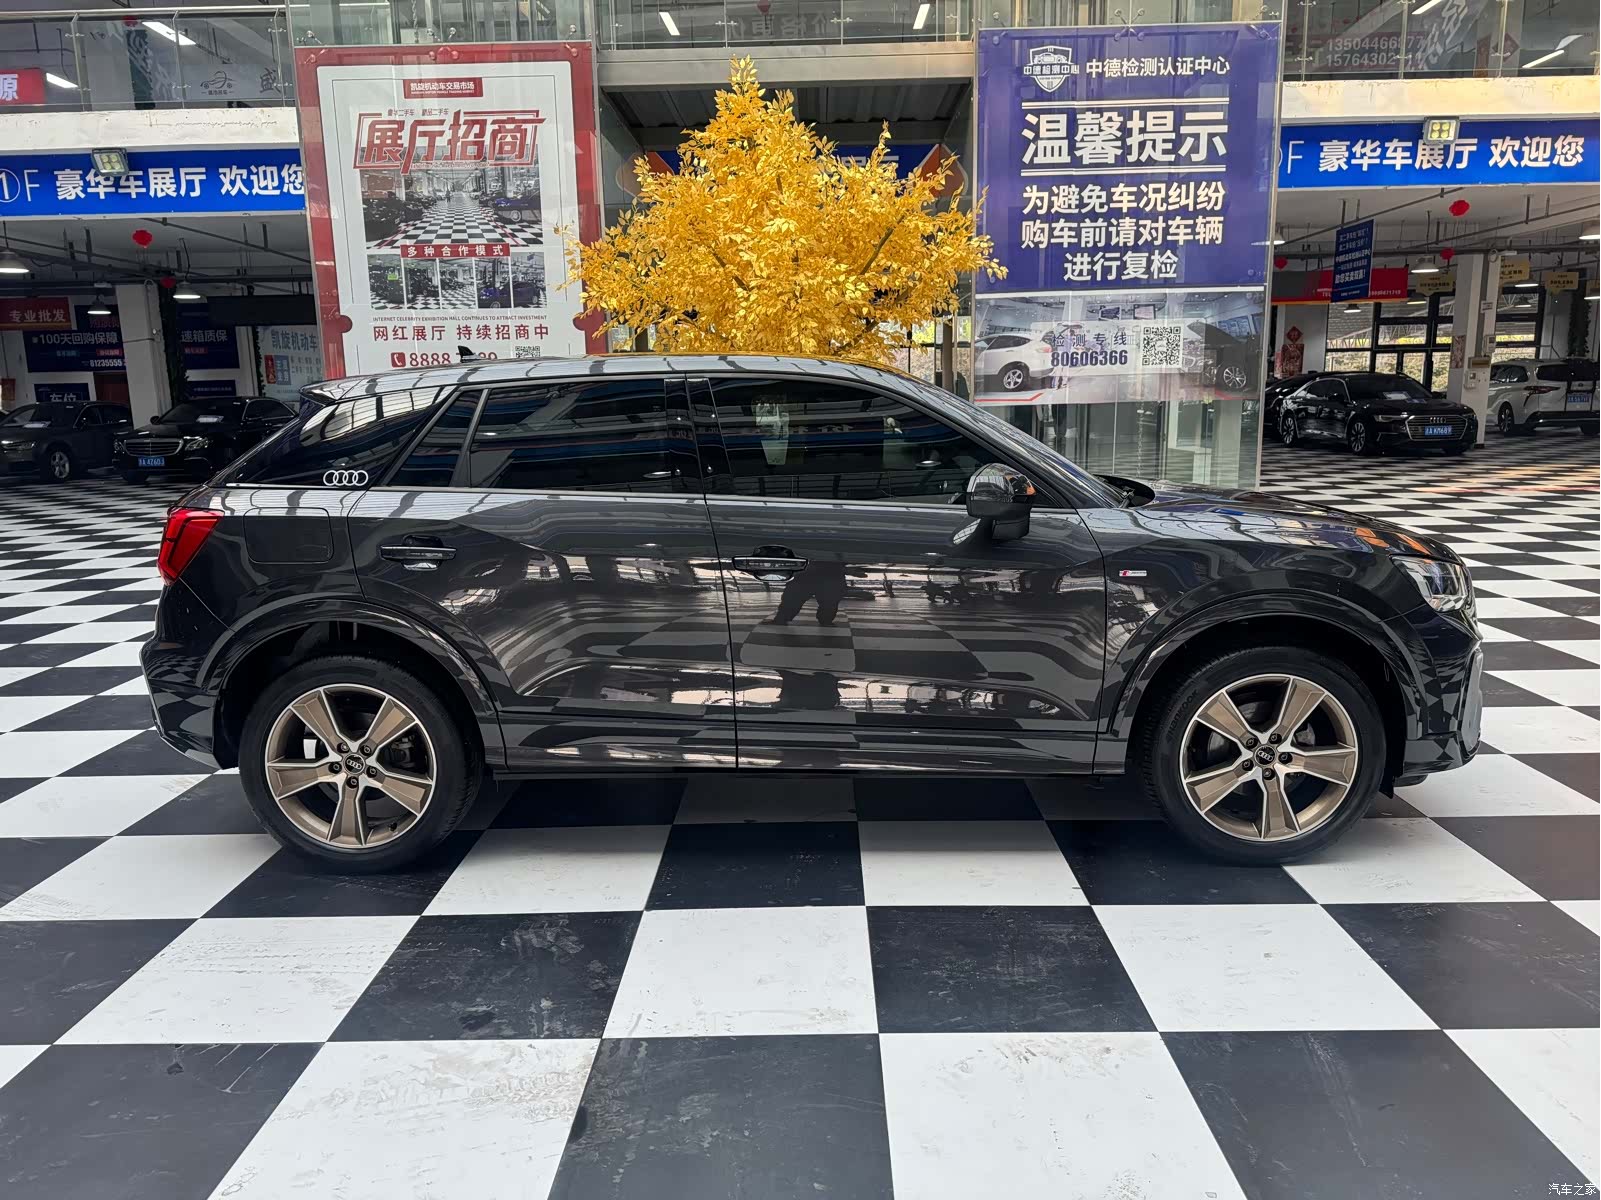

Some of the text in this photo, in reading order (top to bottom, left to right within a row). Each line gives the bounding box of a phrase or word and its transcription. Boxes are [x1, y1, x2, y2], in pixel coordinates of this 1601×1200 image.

[1326, 36, 1424, 51] 1350446677
[1023, 64, 1080, 76] 中德检测中心
[1086, 55, 1230, 79] 中德检测认证中心
[410, 82, 475, 91] 凯旋机动车交易市场
[363, 109, 547, 176] 展厅招商
[1021, 110, 1228, 165] 温馨提示
[1318, 138, 1479, 173] 豪华车展厅
[1488, 134, 1586, 169] 欢迎您
[53, 167, 207, 201] 豪华车展厅
[218, 164, 305, 197] 欢迎您
[1022, 181, 1226, 215] 为避免车况纠纷
[1021, 216, 1224, 249] 购车前请对车辆
[407, 244, 504, 258] 多种合作模式
[1063, 250, 1179, 282] 进行复检
[9, 308, 66, 323] 专业批发
[39, 331, 119, 345] 100天回购保障
[180, 328, 228, 343] 速箱质保
[270, 328, 319, 352] 凯旋机动车
[373, 324, 549, 342] 网红展厅 持续招商中
[1051, 332, 1128, 348] 检测专线
[1050, 350, 1128, 367] 80606366
